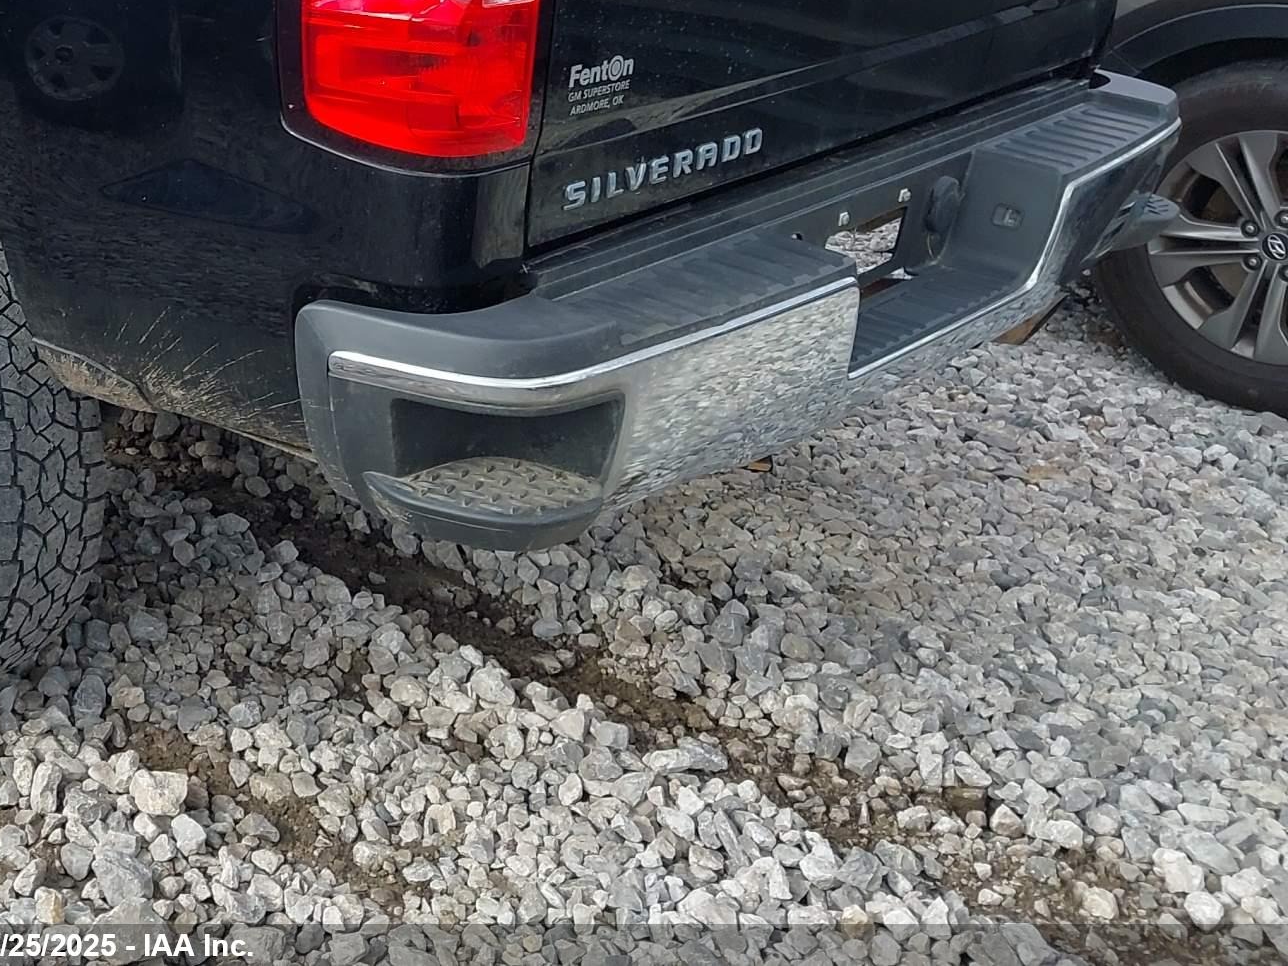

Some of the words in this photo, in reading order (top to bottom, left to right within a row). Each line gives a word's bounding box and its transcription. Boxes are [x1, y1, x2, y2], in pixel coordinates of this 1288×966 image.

[568, 90, 582, 103] GM
[582, 79, 631, 99] SUPERSTORE
[612, 94, 625, 106] OK
[563, 127, 763, 211] SILVERADO
